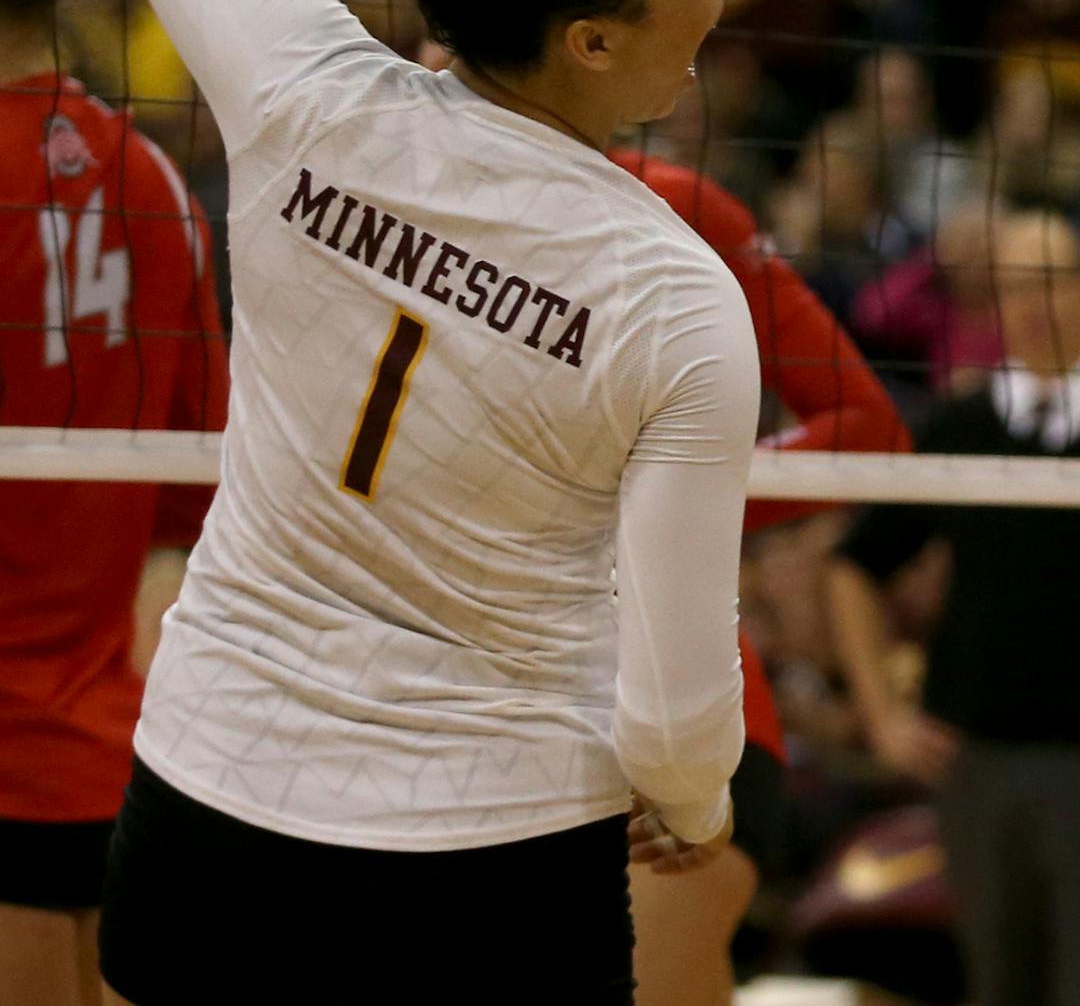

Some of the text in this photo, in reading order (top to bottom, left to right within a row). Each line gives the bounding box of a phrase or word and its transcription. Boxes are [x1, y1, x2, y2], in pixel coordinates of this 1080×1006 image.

[38, 184, 132, 367] 14
[280, 168, 591, 368] MINNESOTA
[338, 305, 429, 503] 1
